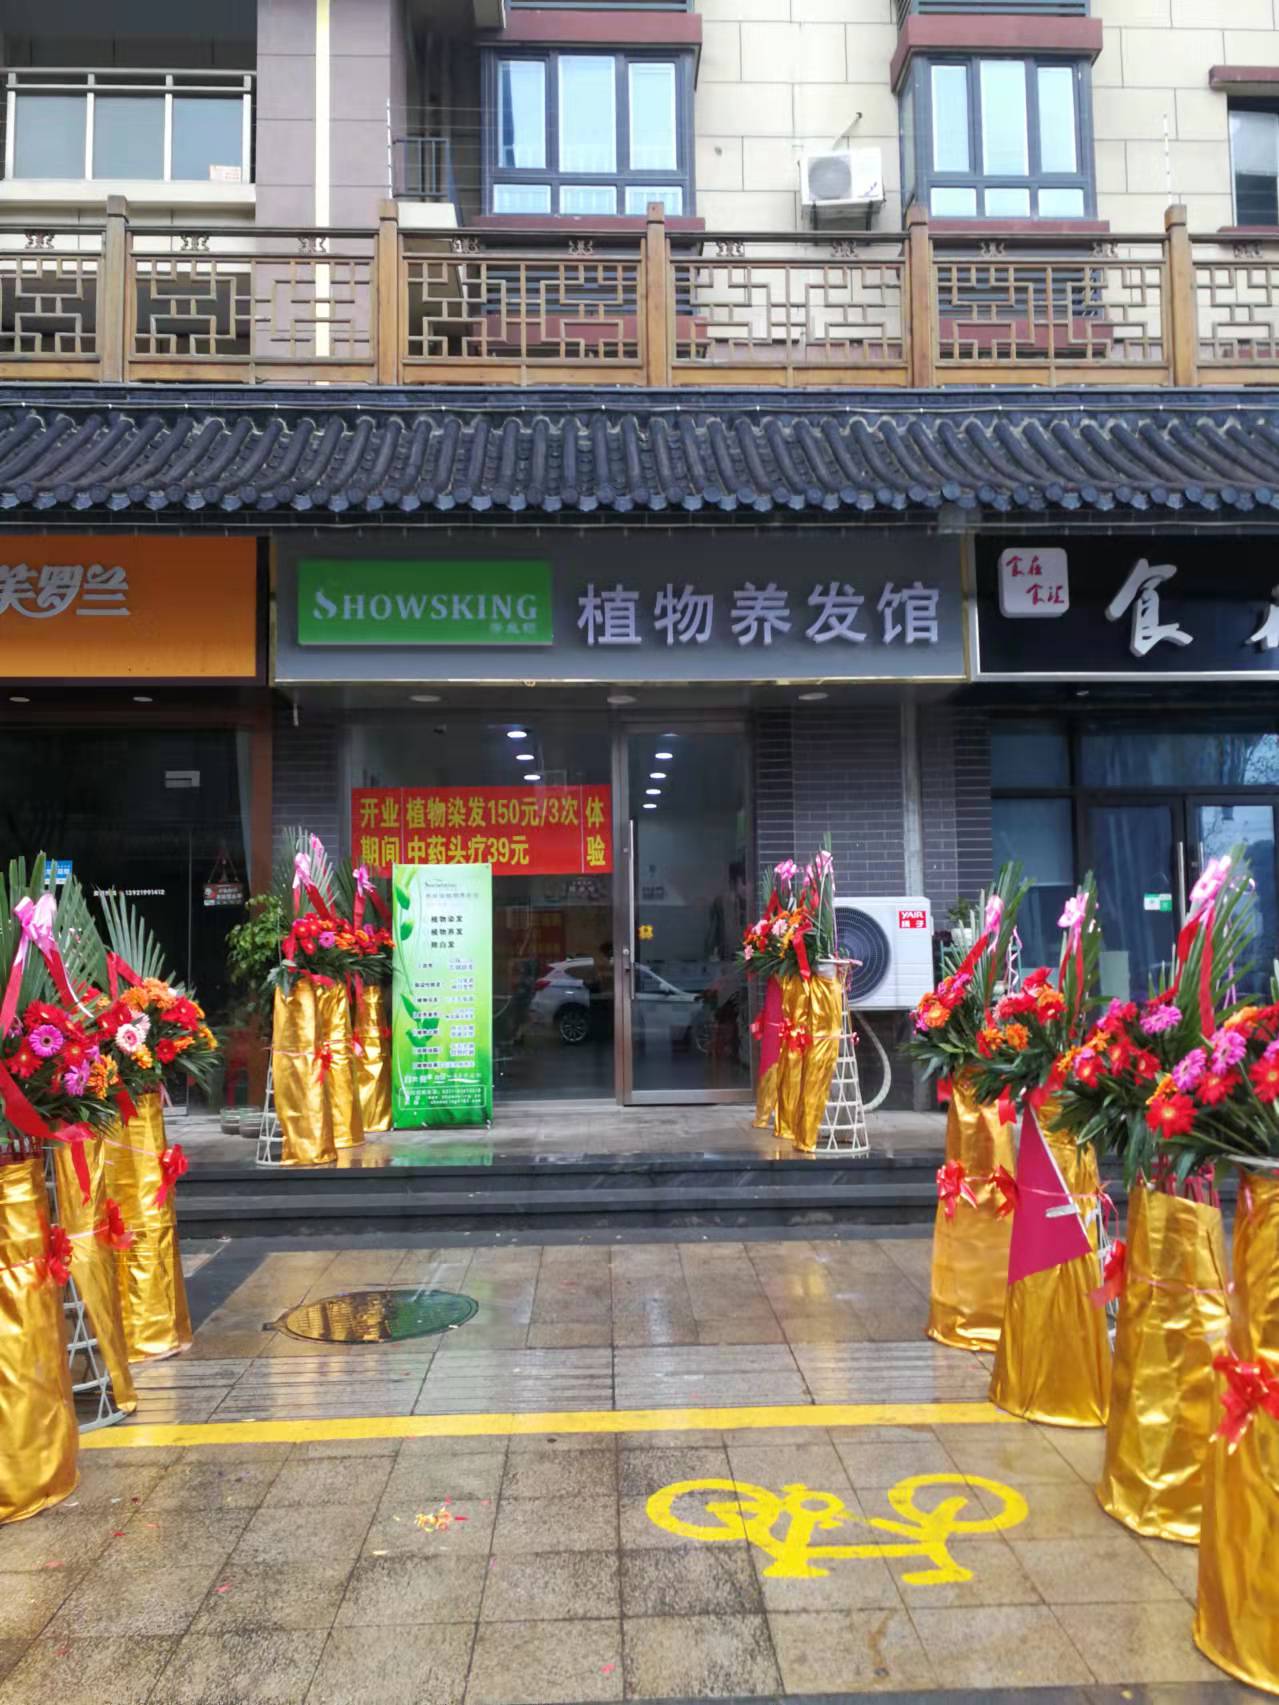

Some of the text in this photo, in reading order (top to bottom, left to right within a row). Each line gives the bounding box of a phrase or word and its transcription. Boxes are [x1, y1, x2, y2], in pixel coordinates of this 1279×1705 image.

[577, 582, 940, 645] 植物养发馆
[359, 796, 578, 829] 开业 植物染发150元/3次
[360, 834, 529, 866] 期间 中药头疗39元
[901, 911, 923, 919] YAIR
